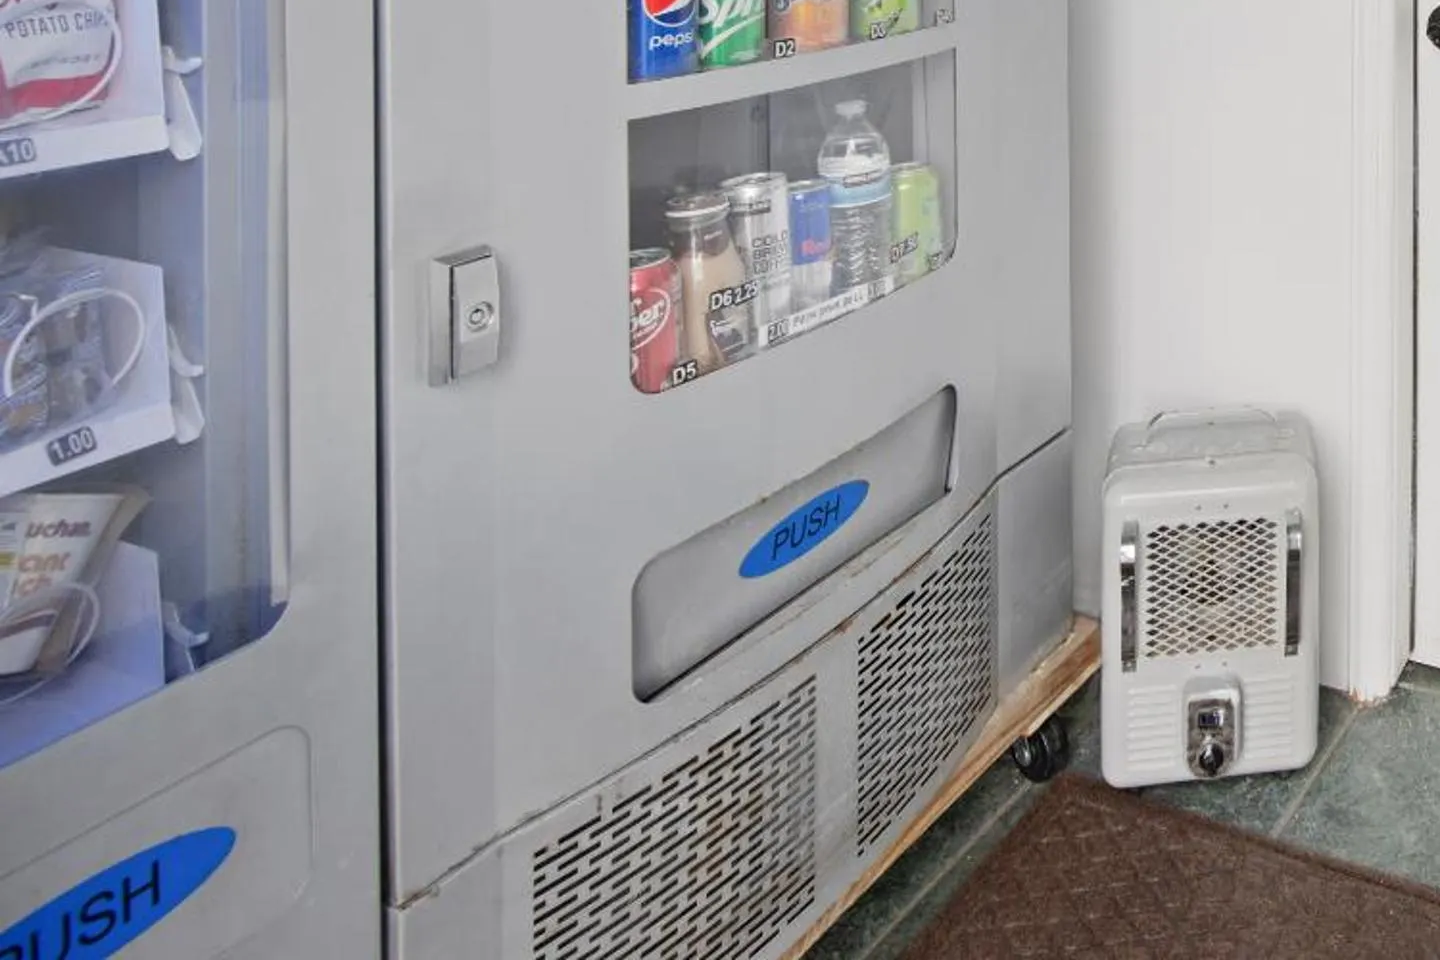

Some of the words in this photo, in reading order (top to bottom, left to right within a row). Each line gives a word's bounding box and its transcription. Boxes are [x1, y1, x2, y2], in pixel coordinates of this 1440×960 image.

[4, 14, 70, 39] POTATO
[775, 41, 795, 58] D2
[711, 289, 732, 310] D6
[673, 361, 698, 387] D5
[52, 429, 94, 462] 1.00
[771, 493, 842, 561] PUSH
